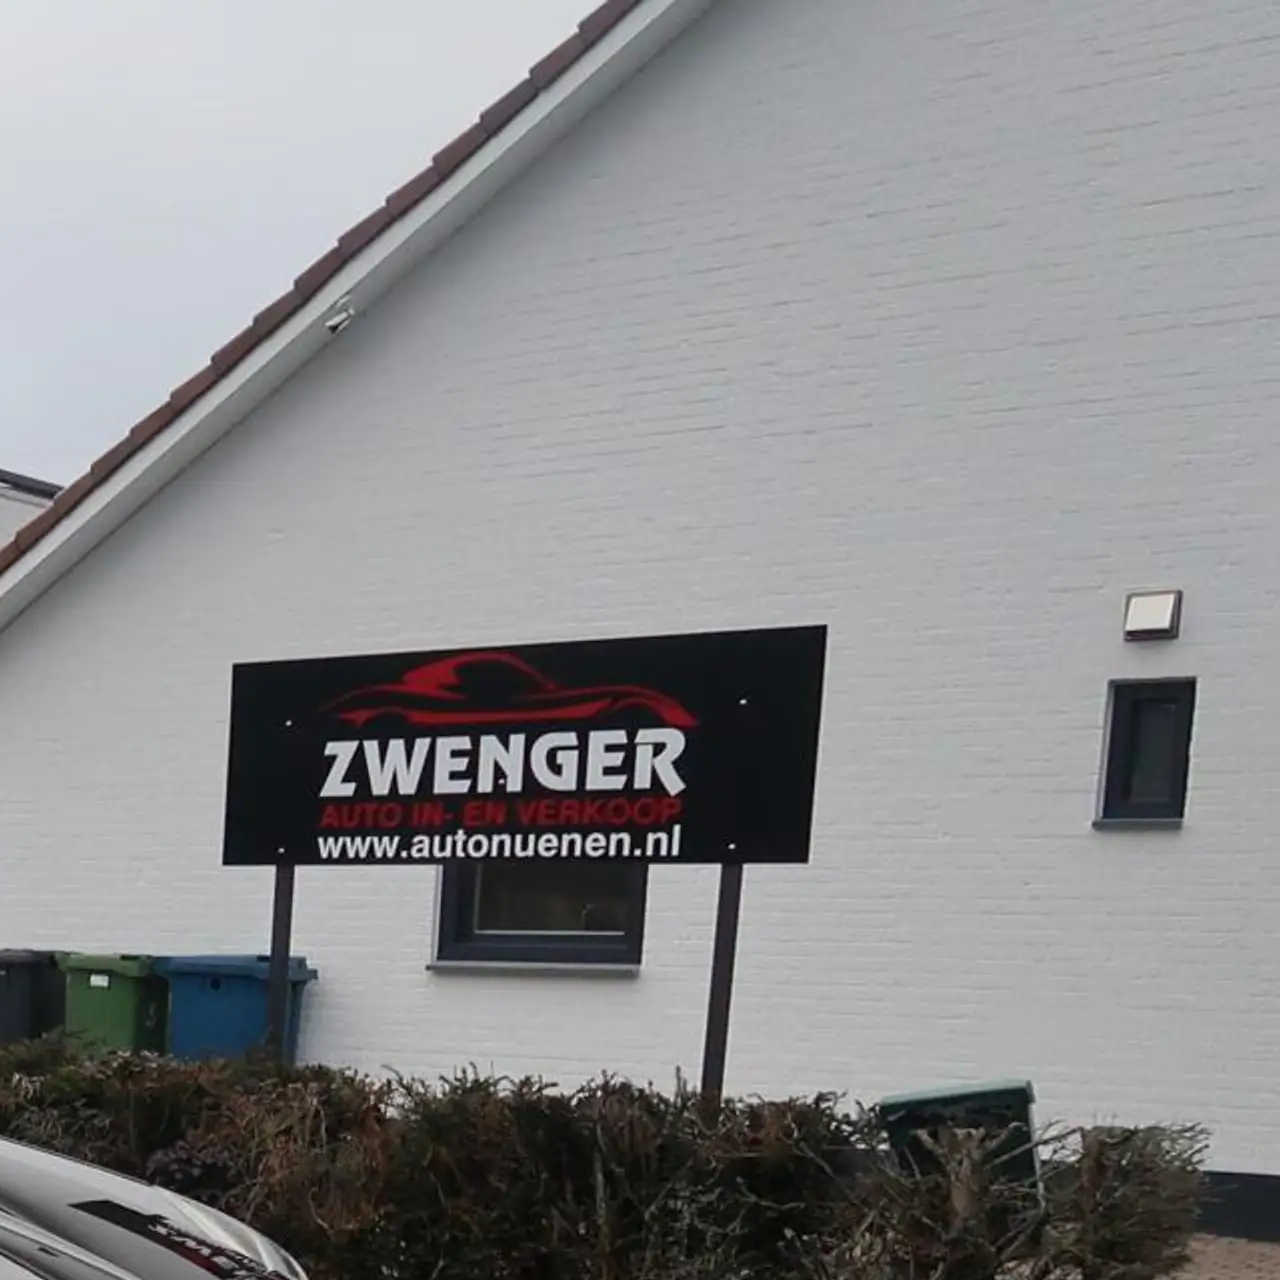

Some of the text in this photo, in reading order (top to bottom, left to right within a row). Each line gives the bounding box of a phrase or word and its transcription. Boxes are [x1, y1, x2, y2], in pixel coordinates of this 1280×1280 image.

[319, 727, 687, 797] ZWENGER
[320, 802, 403, 829] AUTO
[462, 799, 508, 826] EN
[516, 795, 684, 825] VERKOOP
[318, 824, 682, 859] www.autonuenen.nl
